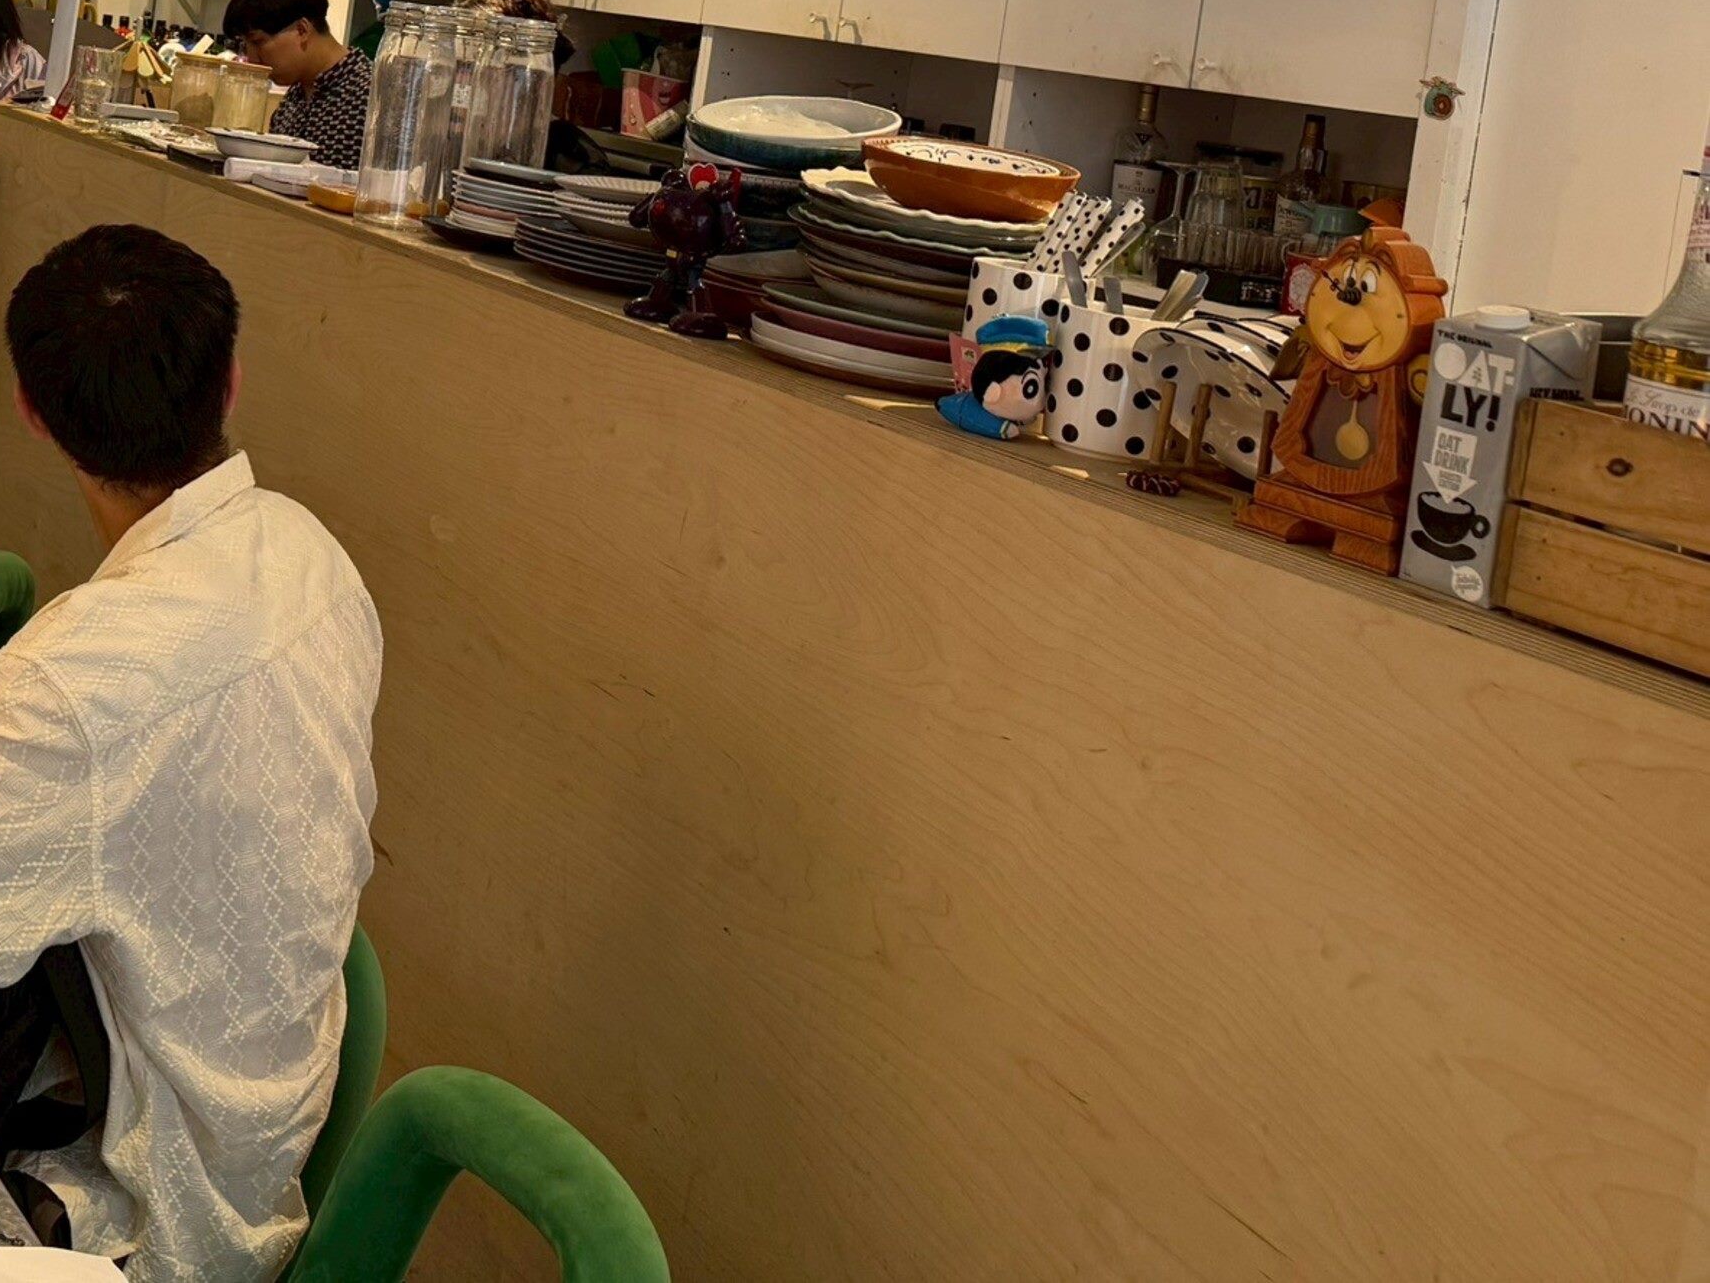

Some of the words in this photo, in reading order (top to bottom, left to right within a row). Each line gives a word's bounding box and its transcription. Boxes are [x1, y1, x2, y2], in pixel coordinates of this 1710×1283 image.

[1434, 342, 1515, 394] OAT
[1441, 382, 1501, 433] LY!
[1624, 404, 1710, 441] ONIN
